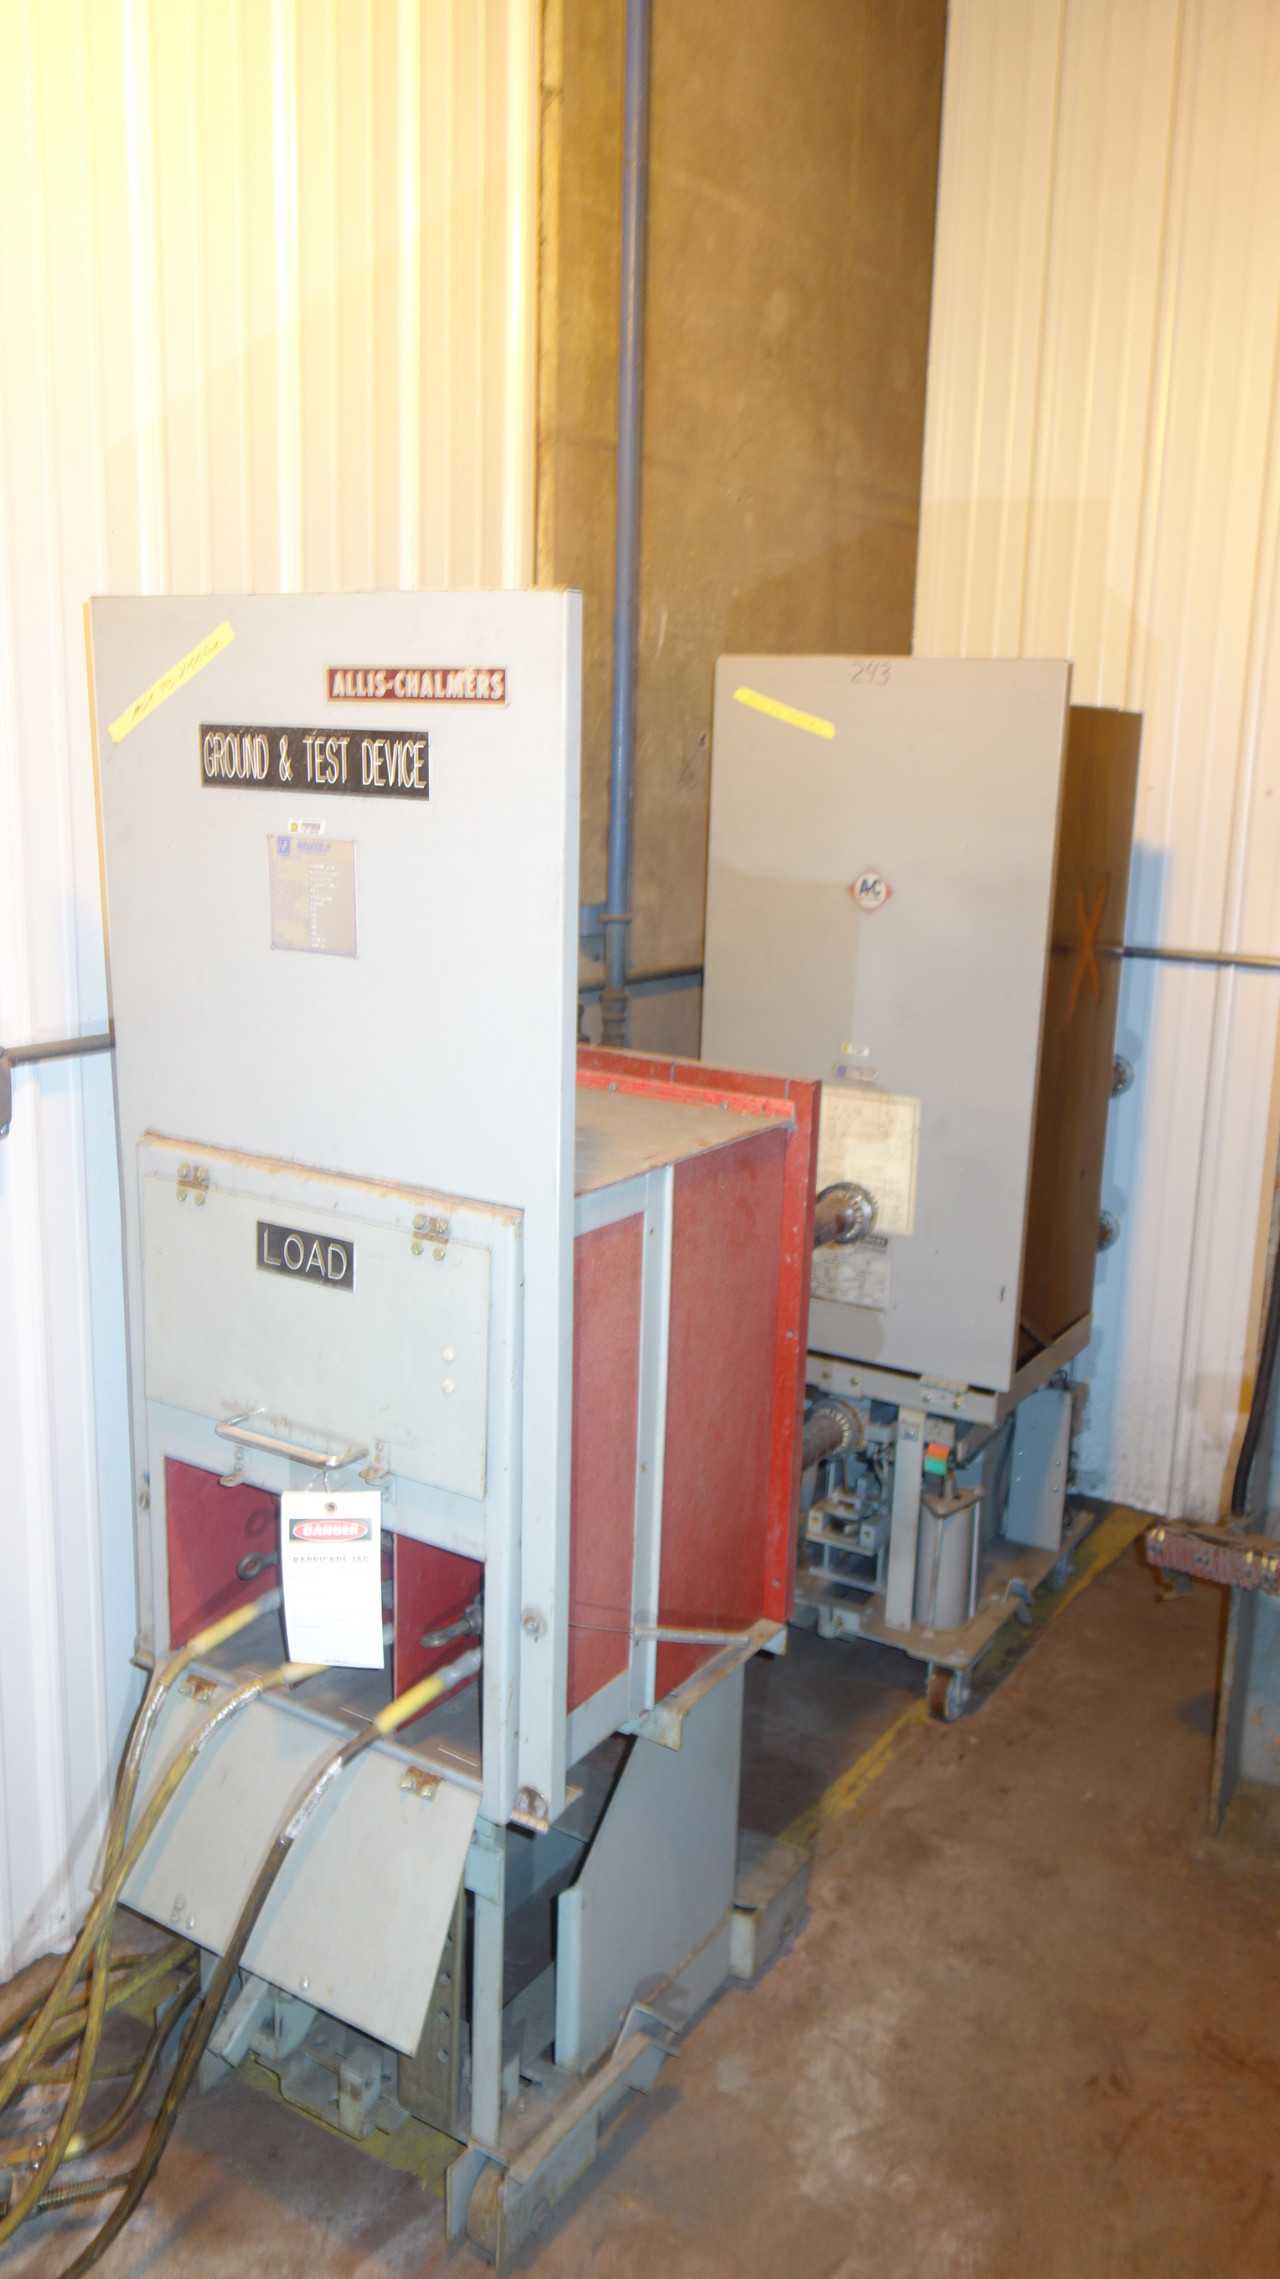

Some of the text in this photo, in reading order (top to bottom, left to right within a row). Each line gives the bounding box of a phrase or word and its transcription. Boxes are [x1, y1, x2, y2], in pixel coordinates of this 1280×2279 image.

[331, 669, 504, 700] ALLIS-CHALMERS
[203, 732, 427, 789] GROUND & TEST DEVICE
[263, 1228, 347, 1280] LOAD
[303, 1522, 359, 1537] DANGER
